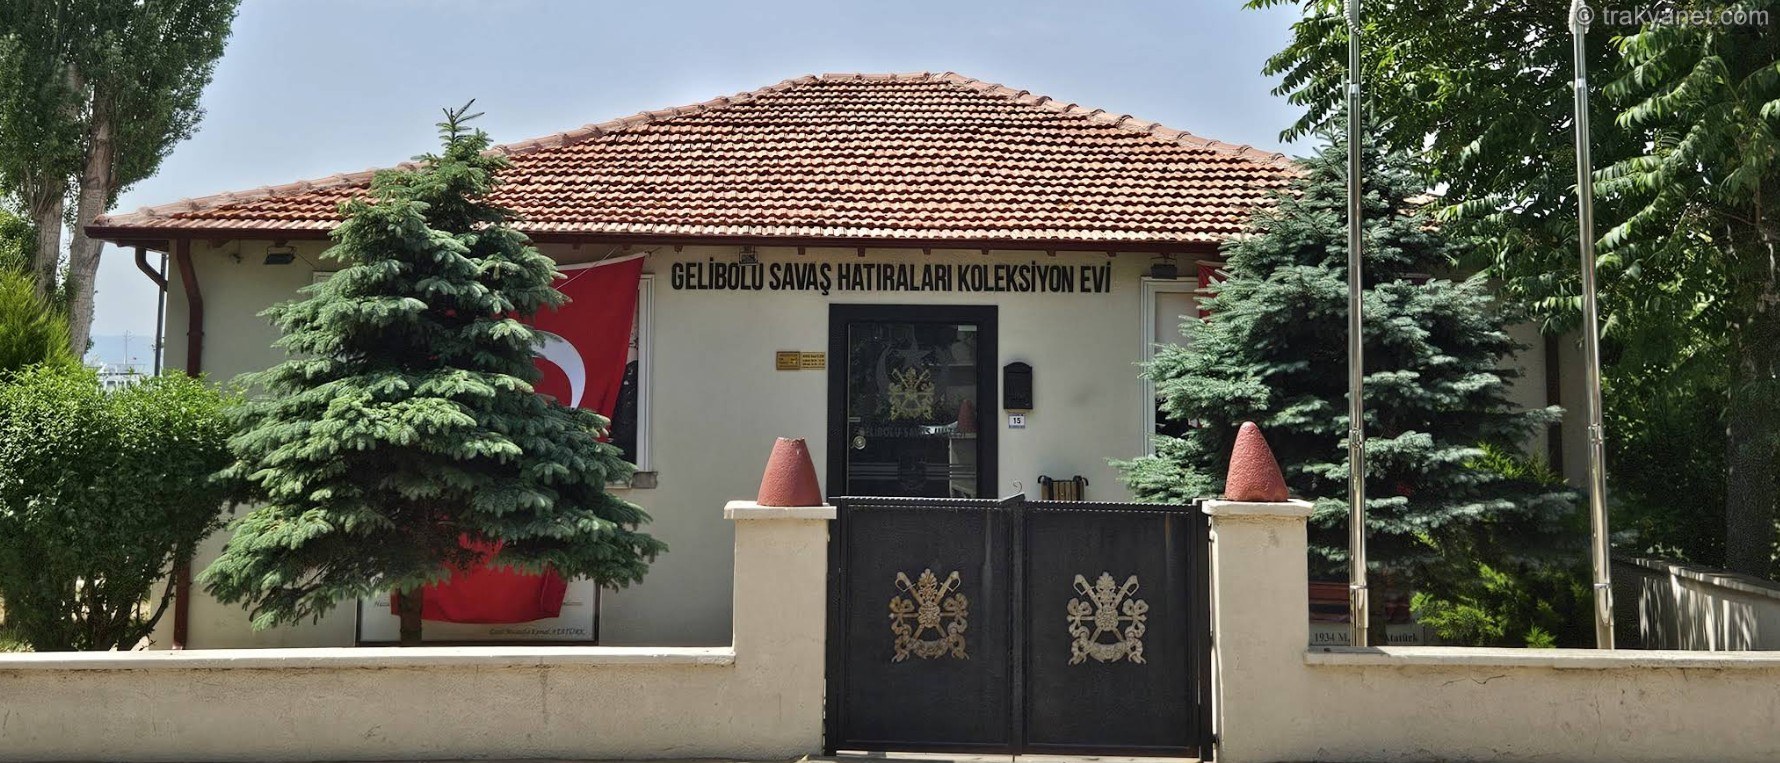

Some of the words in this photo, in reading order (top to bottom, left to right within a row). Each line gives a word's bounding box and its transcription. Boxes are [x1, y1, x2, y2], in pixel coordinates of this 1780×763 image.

[671, 257, 764, 290] GELİBOLU
[769, 262, 831, 295] SAVAŞ
[837, 263, 952, 291] HATIRALARI
[957, 260, 1074, 293] KOLEKSİYON
[1080, 261, 1111, 293] EVİ
[1315, 632, 1335, 641] 1934
